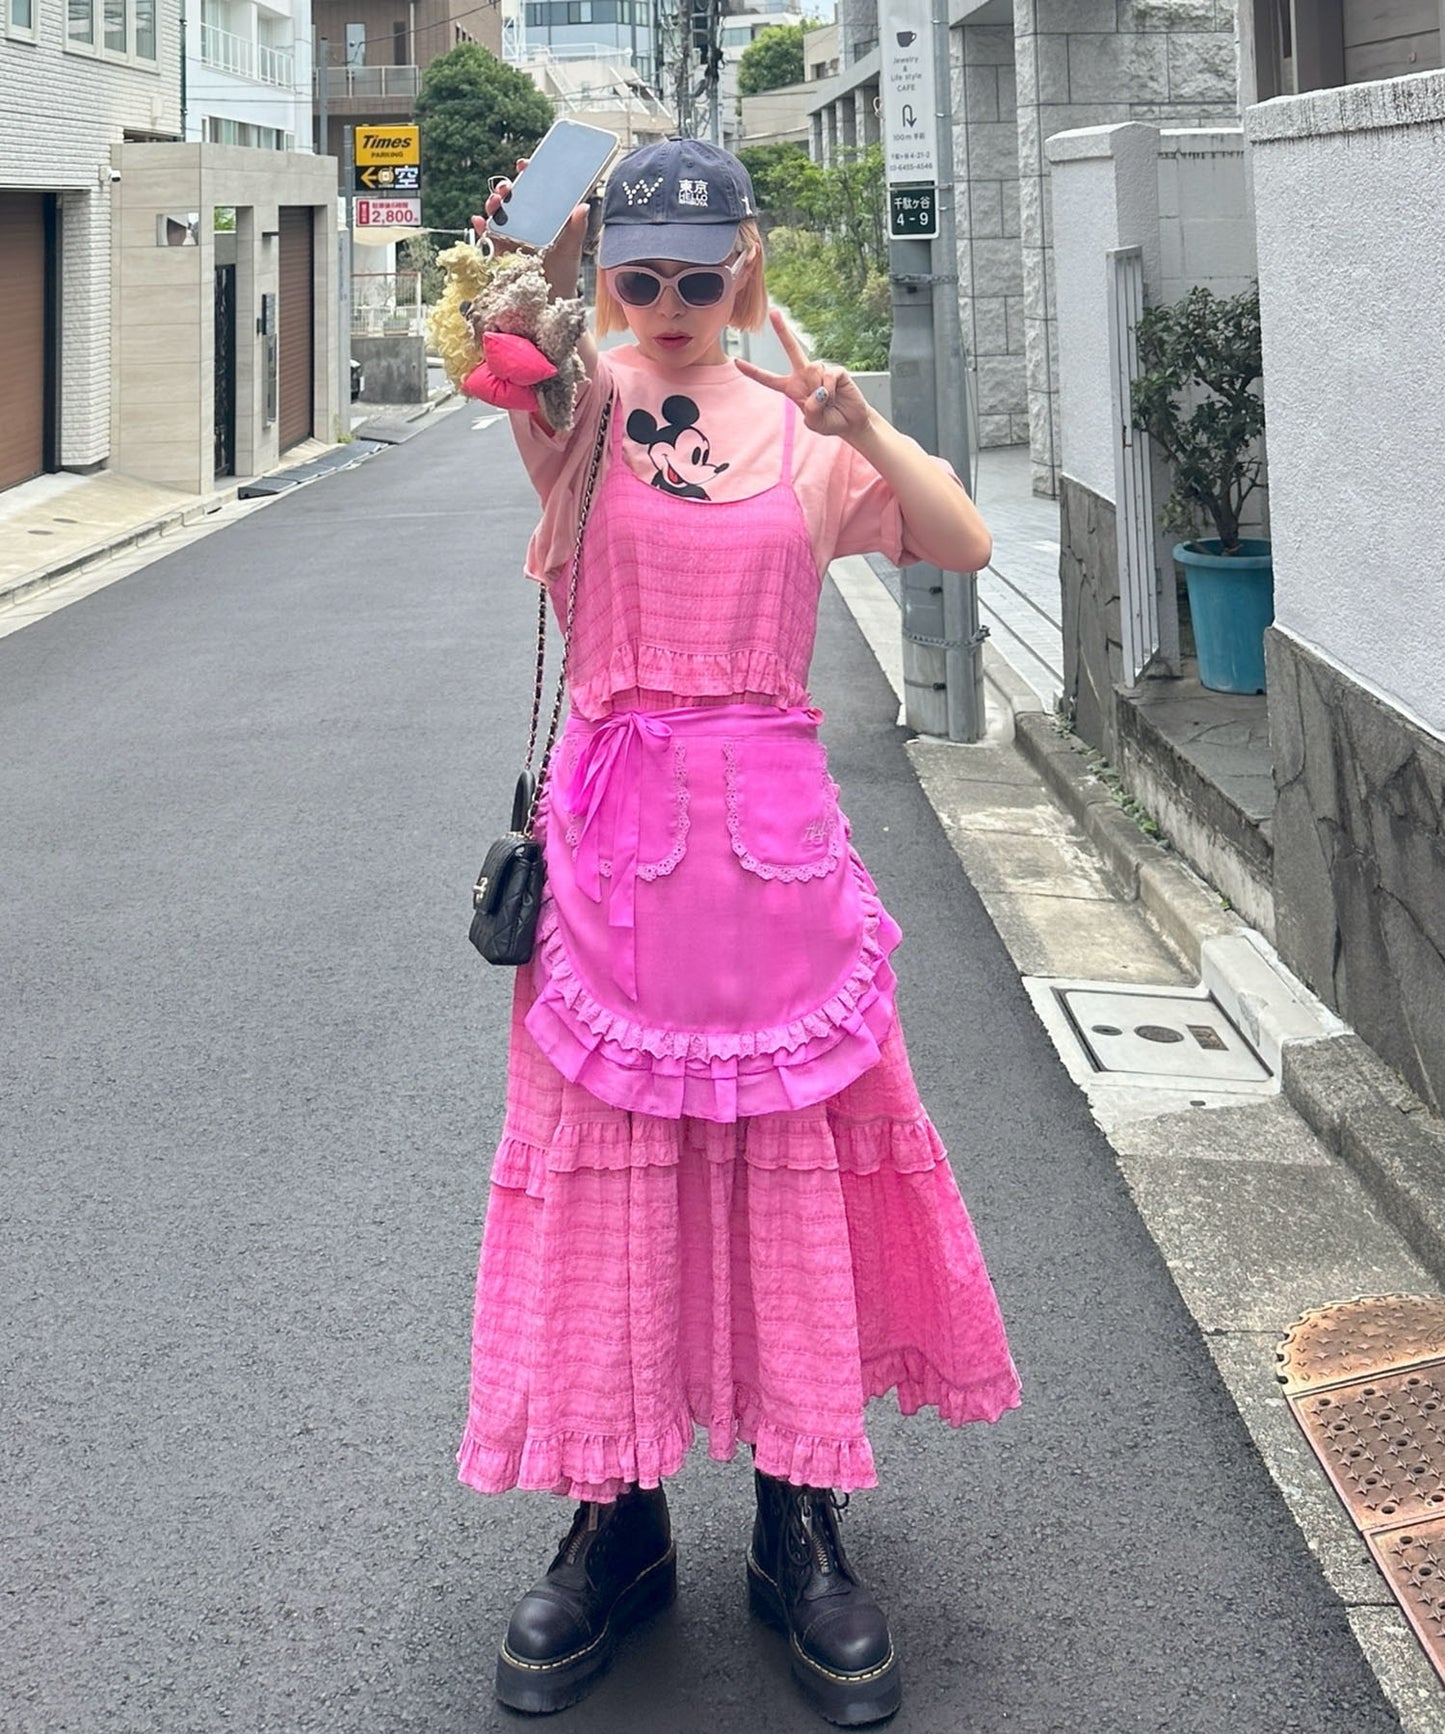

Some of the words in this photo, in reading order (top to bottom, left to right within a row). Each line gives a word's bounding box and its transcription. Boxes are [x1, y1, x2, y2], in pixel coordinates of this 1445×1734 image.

[896, 84, 916, 92] CAFE
[363, 135, 412, 149] Times
[394, 165, 419, 189] 空
[679, 179, 709, 194] 東京
